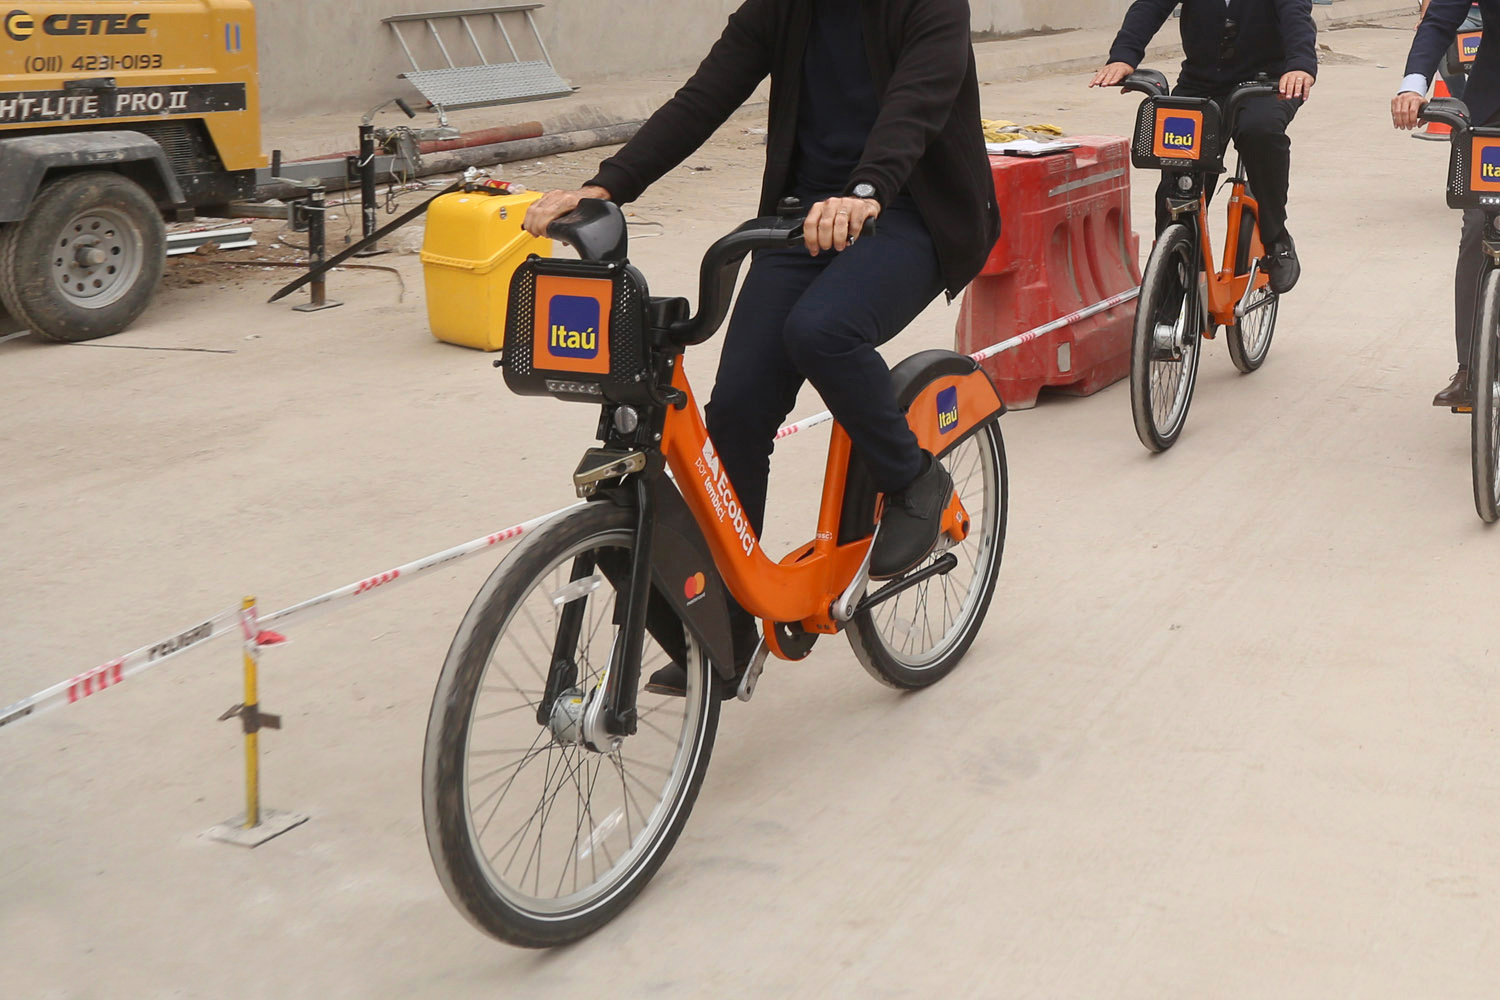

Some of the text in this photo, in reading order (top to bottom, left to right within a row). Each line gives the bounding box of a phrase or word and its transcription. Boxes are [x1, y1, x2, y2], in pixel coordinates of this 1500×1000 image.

[43, 13, 151, 35] CETEC
[25, 54, 163, 72] (011) 4231-0193
[116, 92, 164, 112] PRO
[1164, 132, 1193, 146] Itaú
[551, 324, 596, 350] Itaú
[938, 406, 958, 429] Itaú
[695, 457, 707, 476] por
[717, 471, 755, 557] Ecobici
